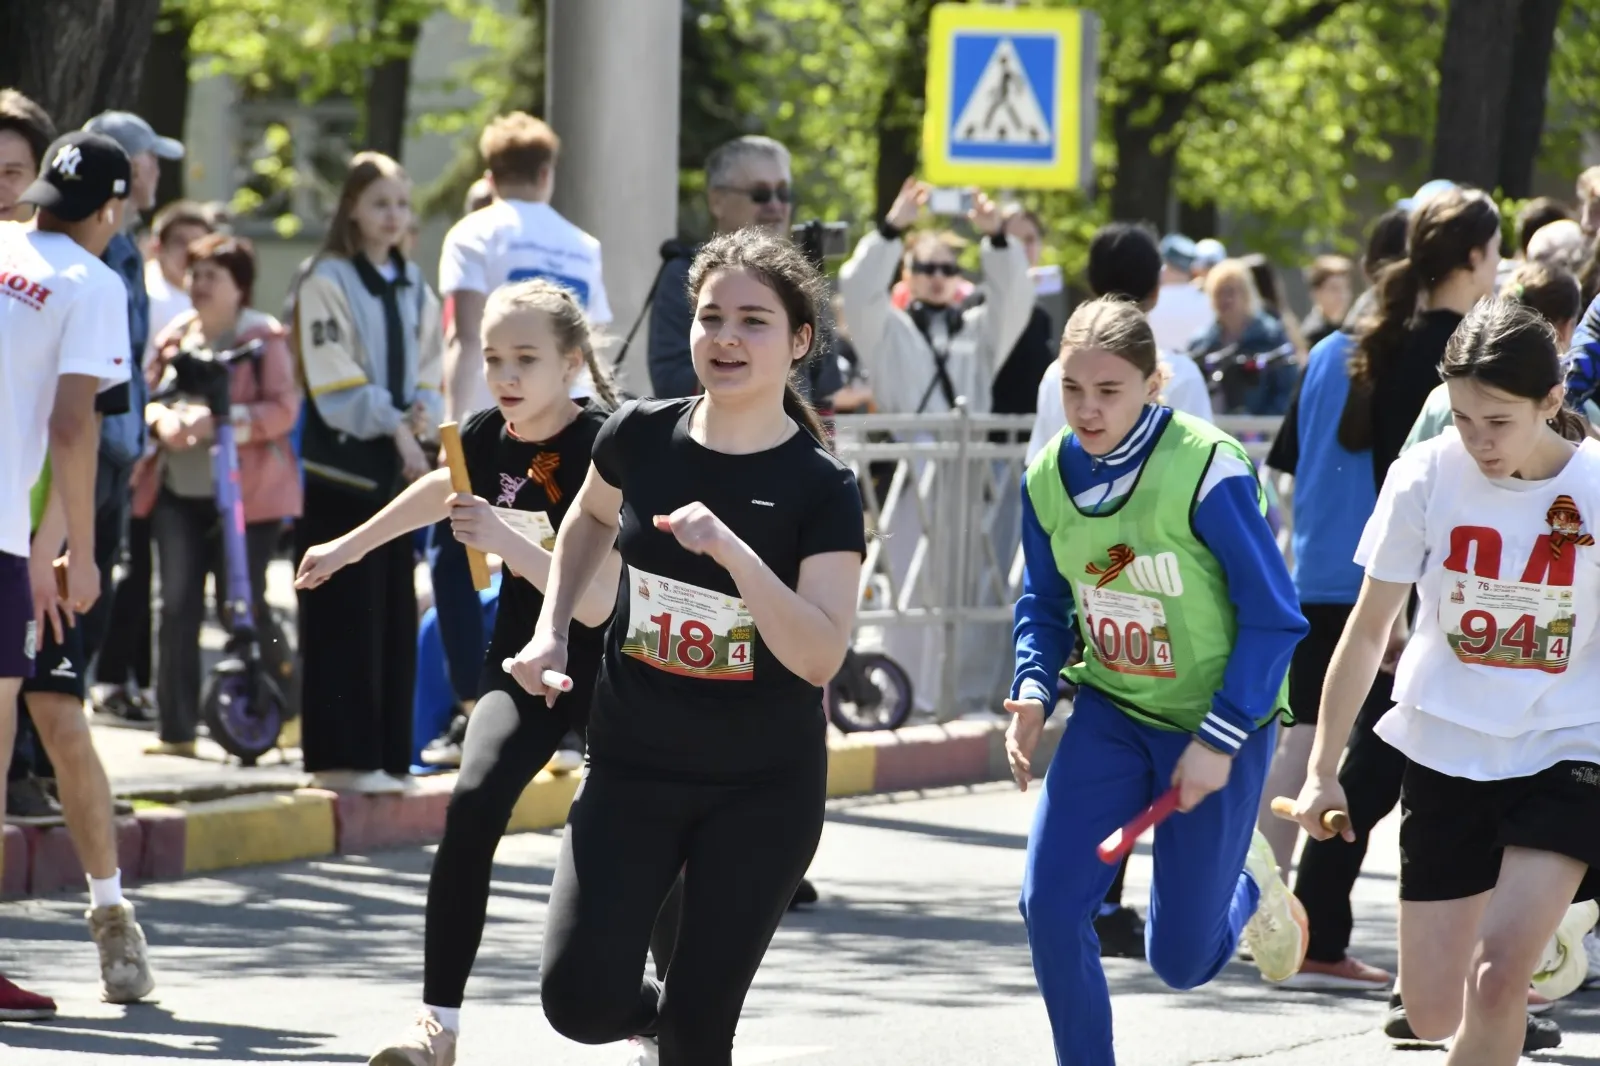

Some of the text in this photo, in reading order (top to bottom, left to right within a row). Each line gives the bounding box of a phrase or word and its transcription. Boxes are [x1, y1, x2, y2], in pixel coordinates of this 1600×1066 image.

[650, 611, 716, 669] 18
[731, 632, 750, 640] 2025
[1459, 609, 1540, 659] 94
[731, 643, 747, 663] 4
[1156, 643, 1169, 663] 4
[1549, 638, 1565, 658] 4
